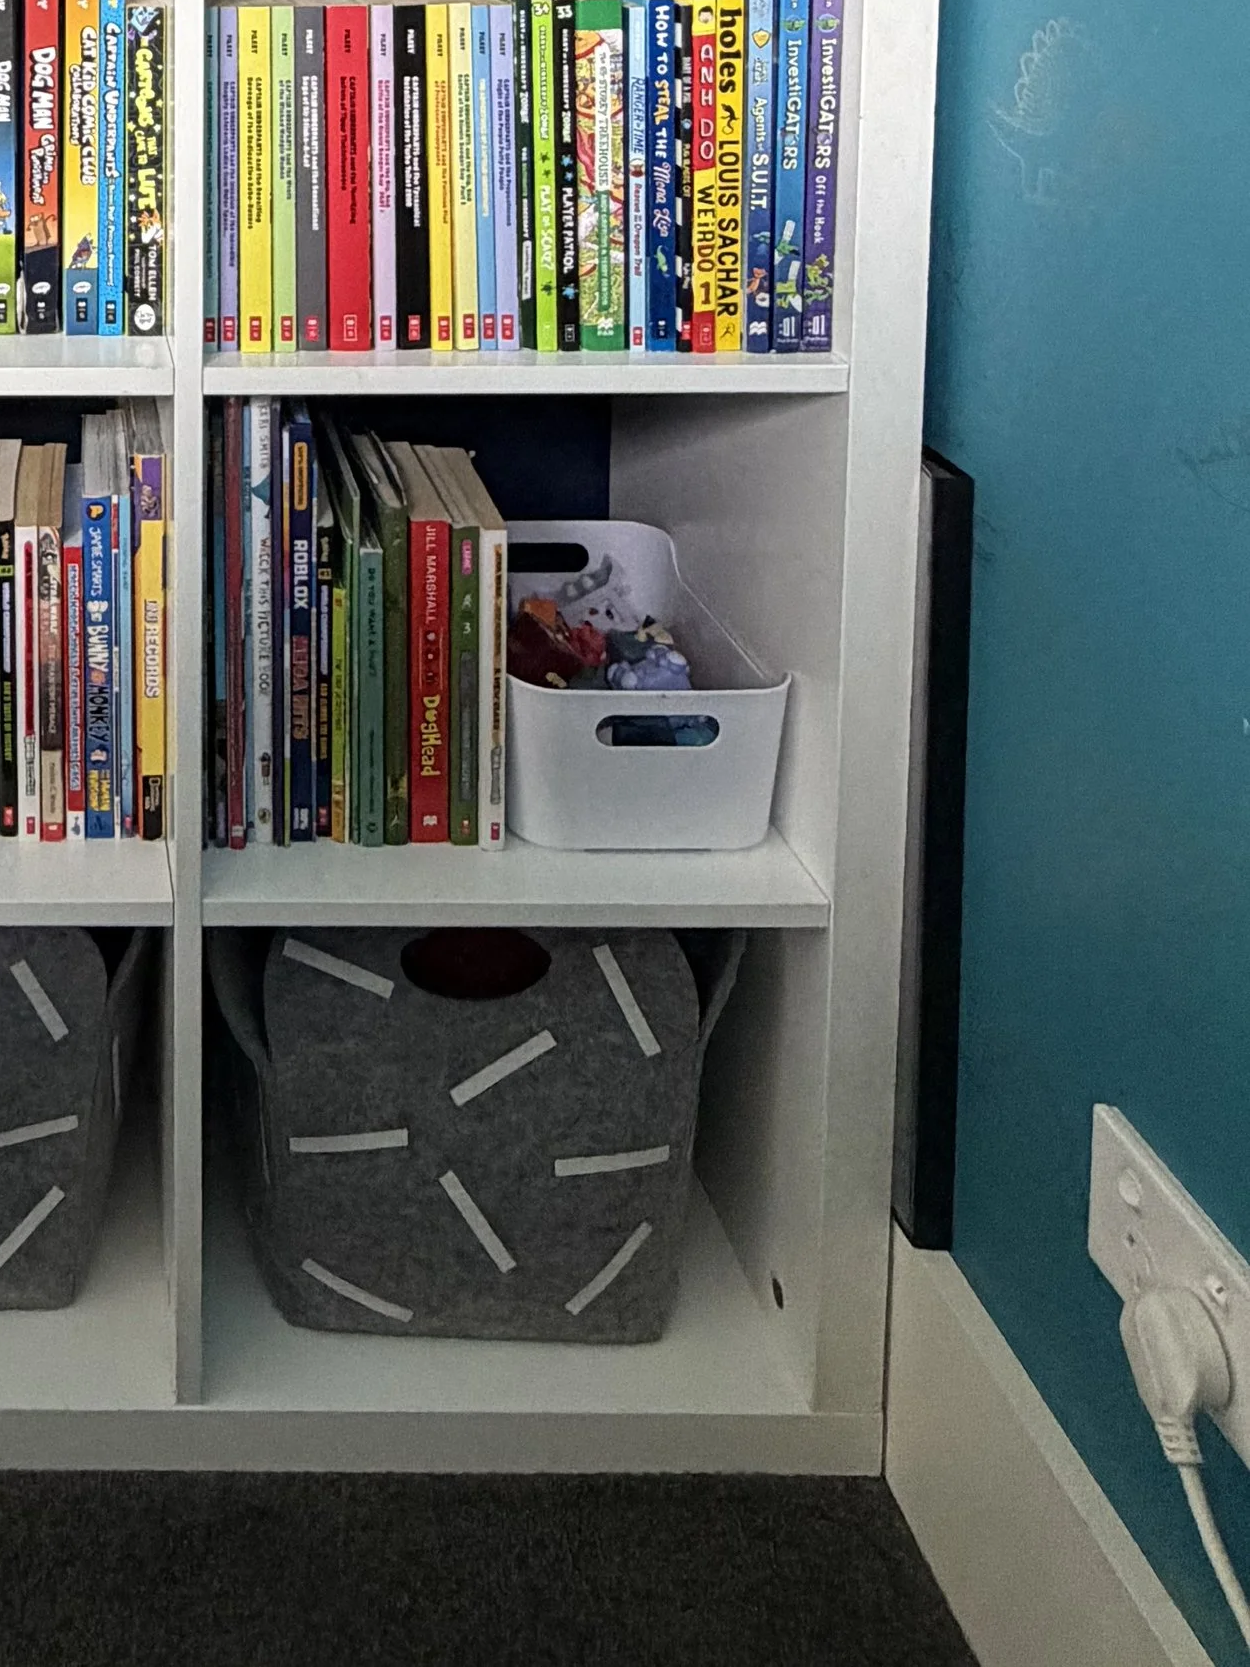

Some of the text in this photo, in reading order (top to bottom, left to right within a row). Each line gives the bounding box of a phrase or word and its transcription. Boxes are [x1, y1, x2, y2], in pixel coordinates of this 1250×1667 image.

[82, 26, 96, 57] CAT
[655, 6, 669, 47] HOW
[719, 7, 742, 94] holes
[656, 52, 668, 75] TO
[632, 77, 644, 154] RANGER TIME
[654, 79, 668, 125] STEAL
[700, 44, 714, 160] ANH DO
[82, 146, 96, 185] CLUB
[655, 127, 667, 159] THE
[751, 98, 768, 210] Agents S.U.I.T.
[654, 162, 672, 204] Mona
[561, 187, 574, 274] PLAYER PATROL
[632, 183, 642, 276] Rescue Oregon Trail
[718, 140, 738, 316] LOUIS SACHAR
[148, 245, 157, 301] TOM ELLEN
[293, 539, 309, 610] ROBLOX
[425, 525, 437, 624] JILL MARSHALL
[88, 625, 109, 672] BUNNY
[144, 625, 159, 698] RECORDS
